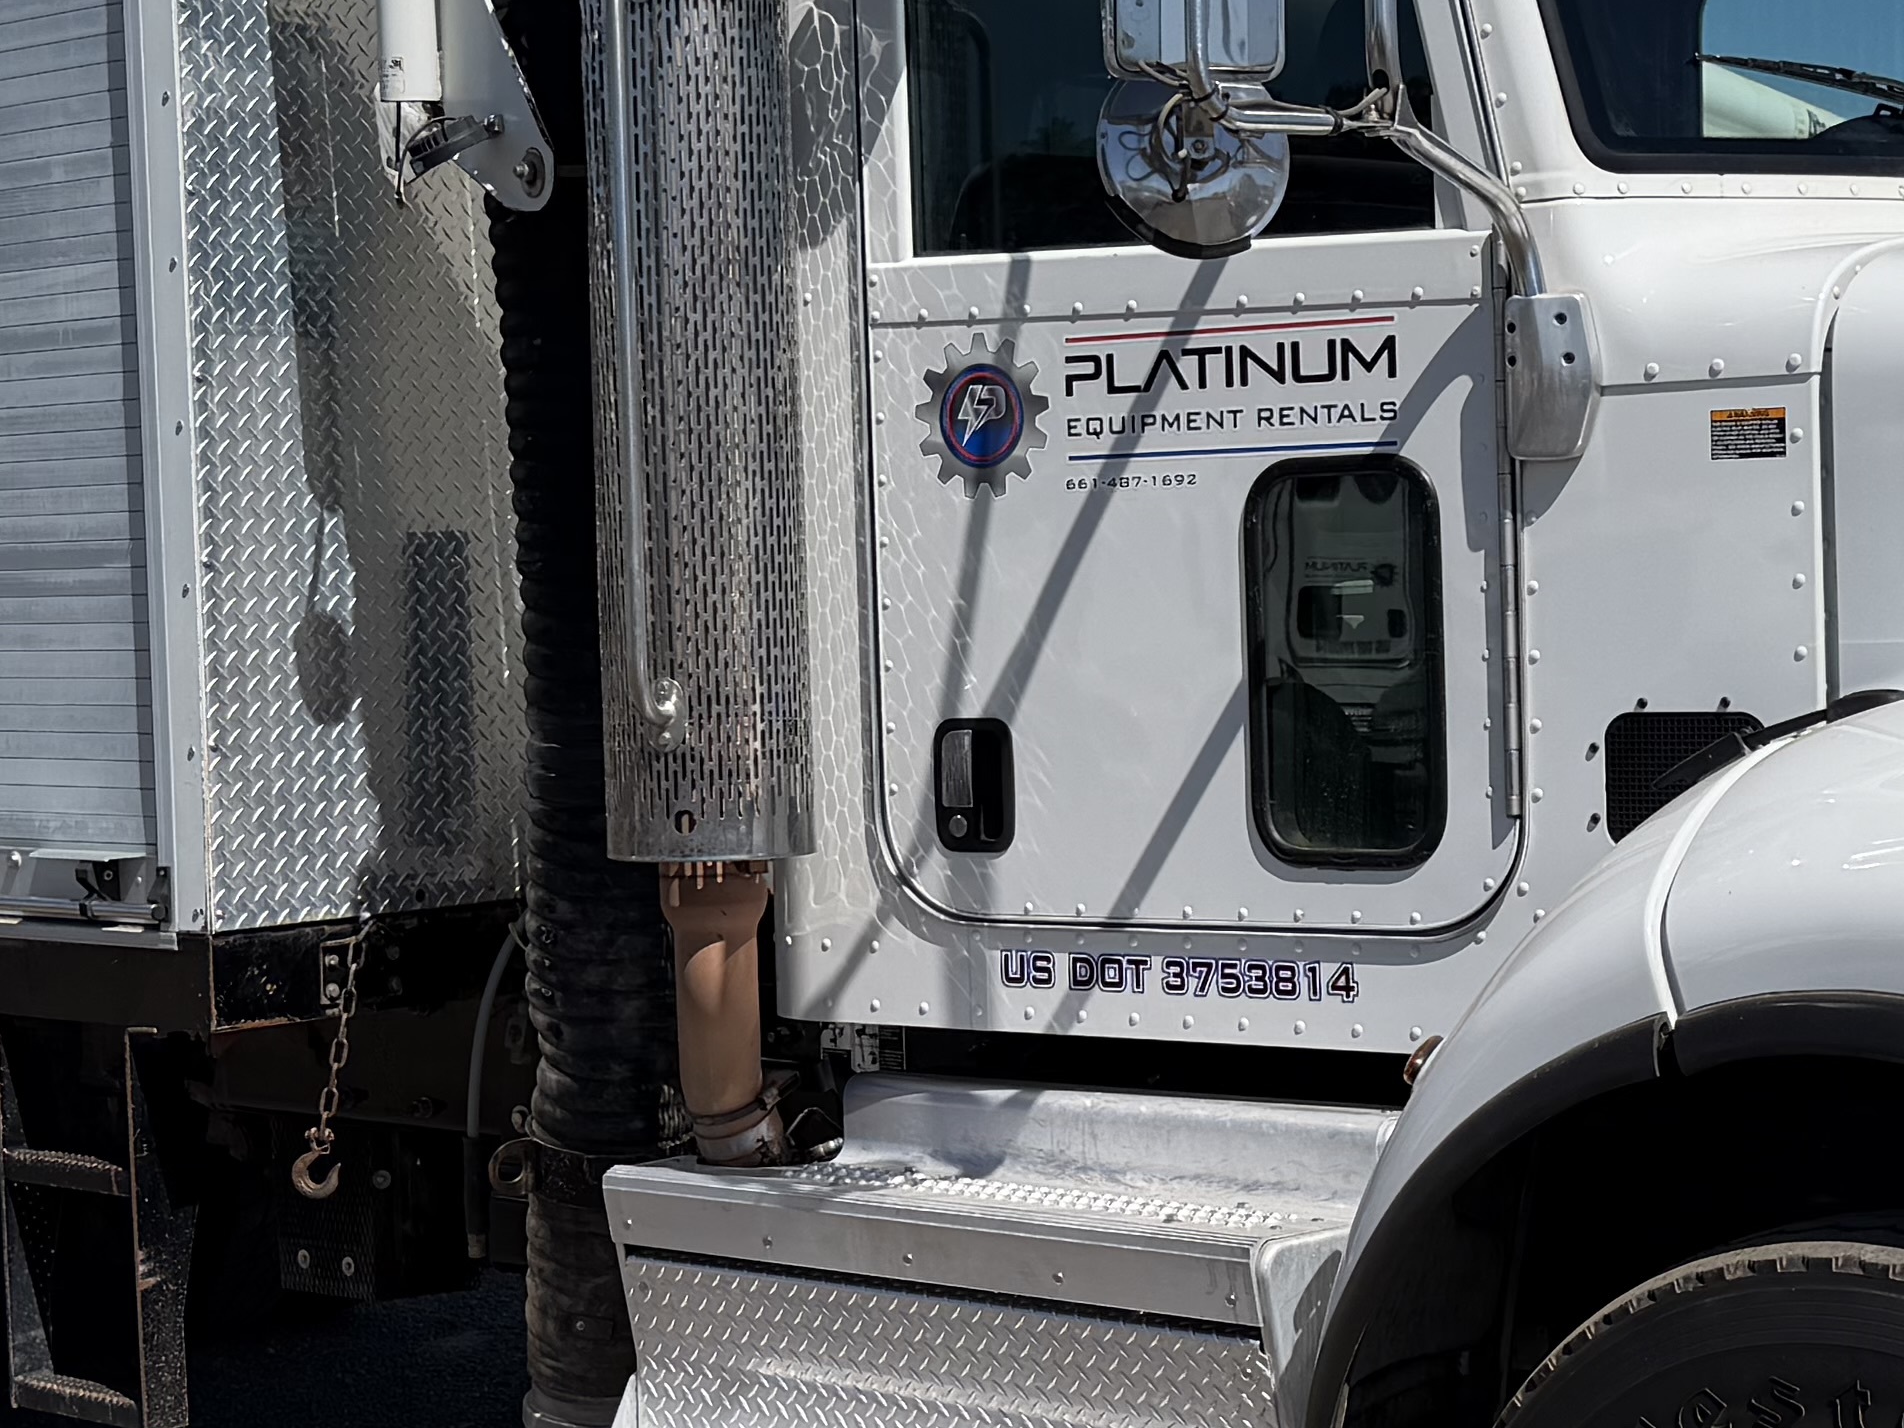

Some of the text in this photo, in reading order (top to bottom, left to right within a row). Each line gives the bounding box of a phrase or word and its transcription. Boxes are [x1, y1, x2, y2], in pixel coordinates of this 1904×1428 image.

[1064, 334, 1398, 397] PLATINUM
[1066, 400, 1398, 440] EQUIPMENT RENTALS
[1065, 473, 1198, 491] 661-487-1692
[999, 949, 1360, 1005] US DOT 3753814
